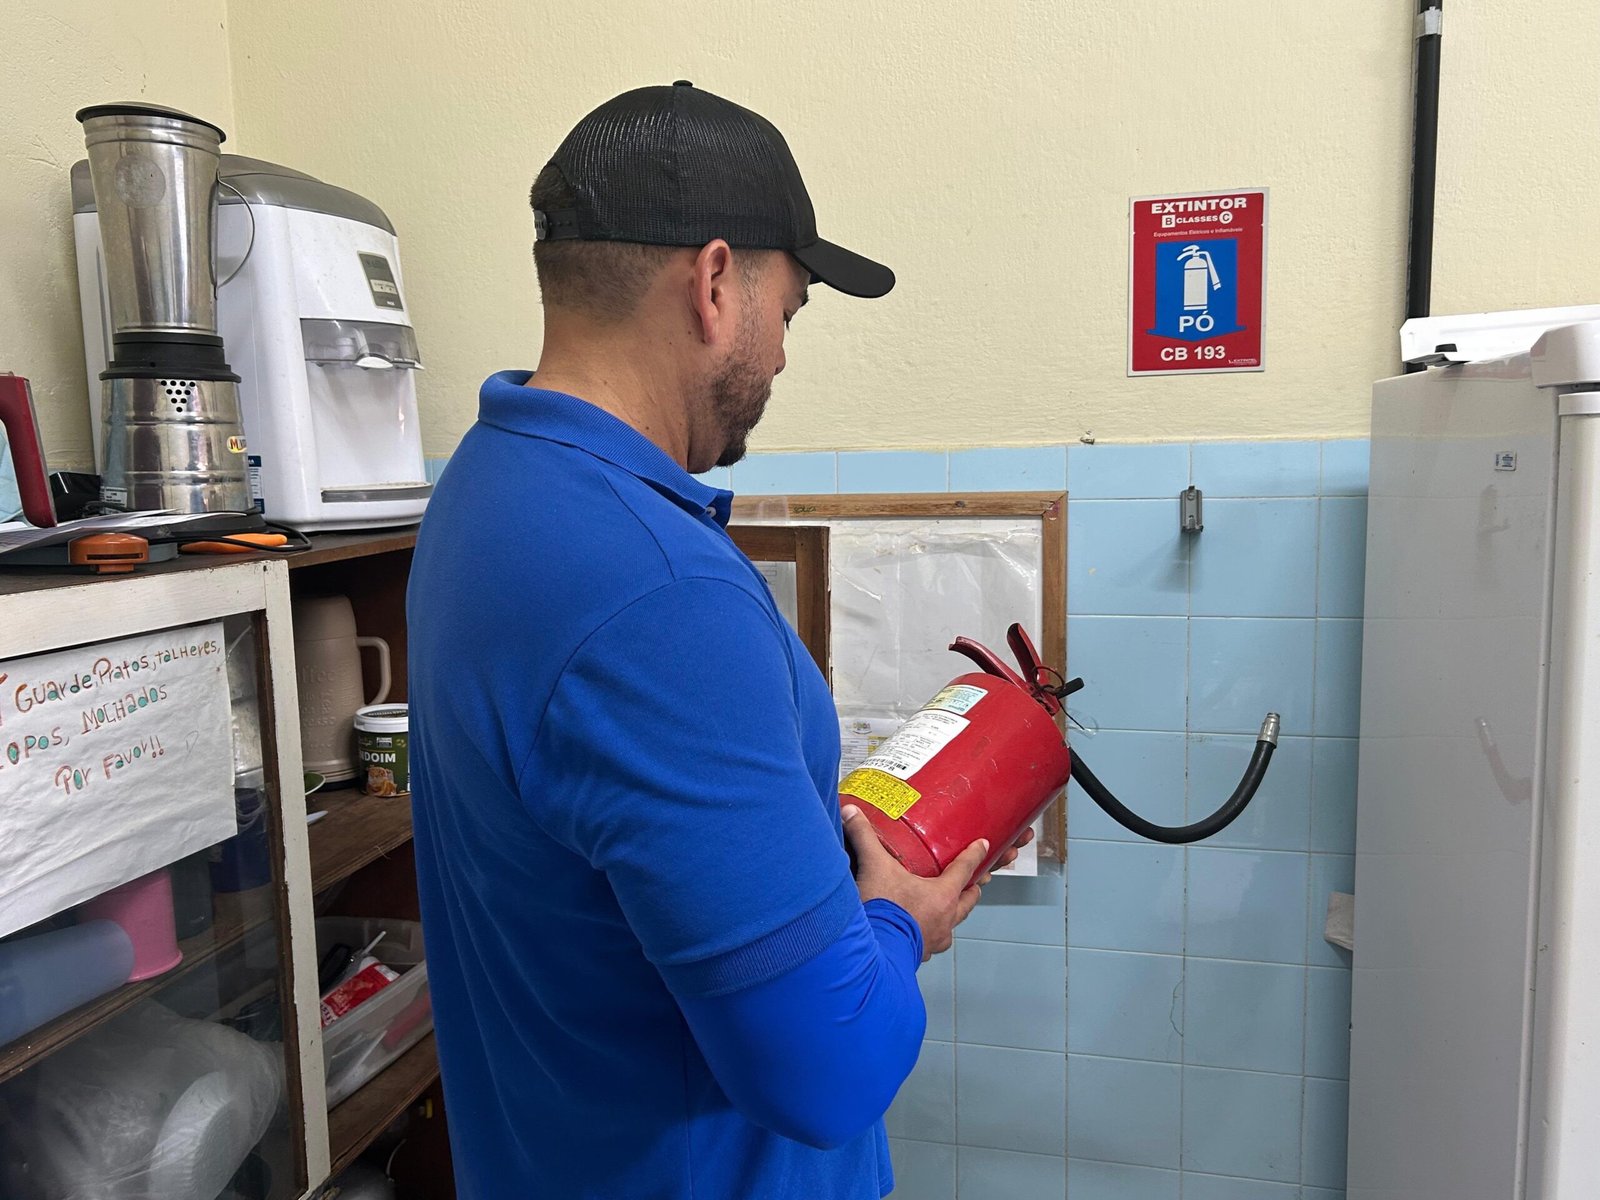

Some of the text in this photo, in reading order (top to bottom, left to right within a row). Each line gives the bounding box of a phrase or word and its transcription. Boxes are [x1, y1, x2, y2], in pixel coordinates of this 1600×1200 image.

[1151, 197, 1247, 214] EXTINTOR
[1176, 215, 1218, 224] CLASSES
[1179, 310, 1214, 333] PÓ
[1160, 345, 1226, 361] CB 193
[55, 765, 91, 795] Por
